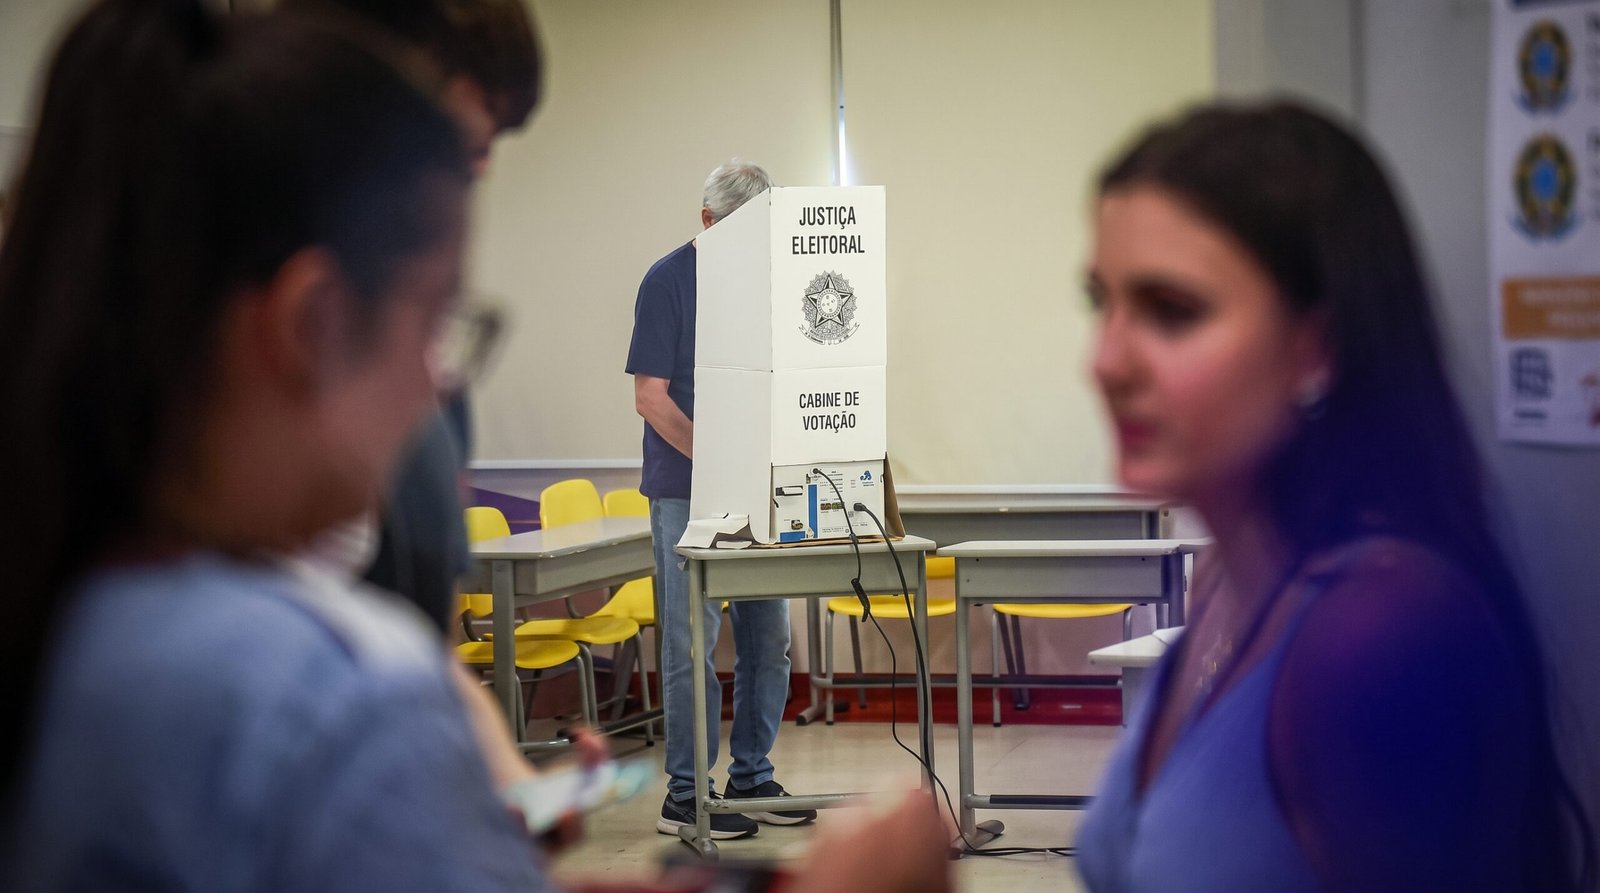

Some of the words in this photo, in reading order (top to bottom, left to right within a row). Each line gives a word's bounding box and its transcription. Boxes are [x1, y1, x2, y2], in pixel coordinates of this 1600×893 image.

[799, 206, 856, 229] JUSTIÇA
[792, 235, 865, 255] ELEITORAL
[799, 392, 841, 408] CABINE
[844, 391, 860, 406] DE
[803, 411, 856, 433] VOTAÇÃO
